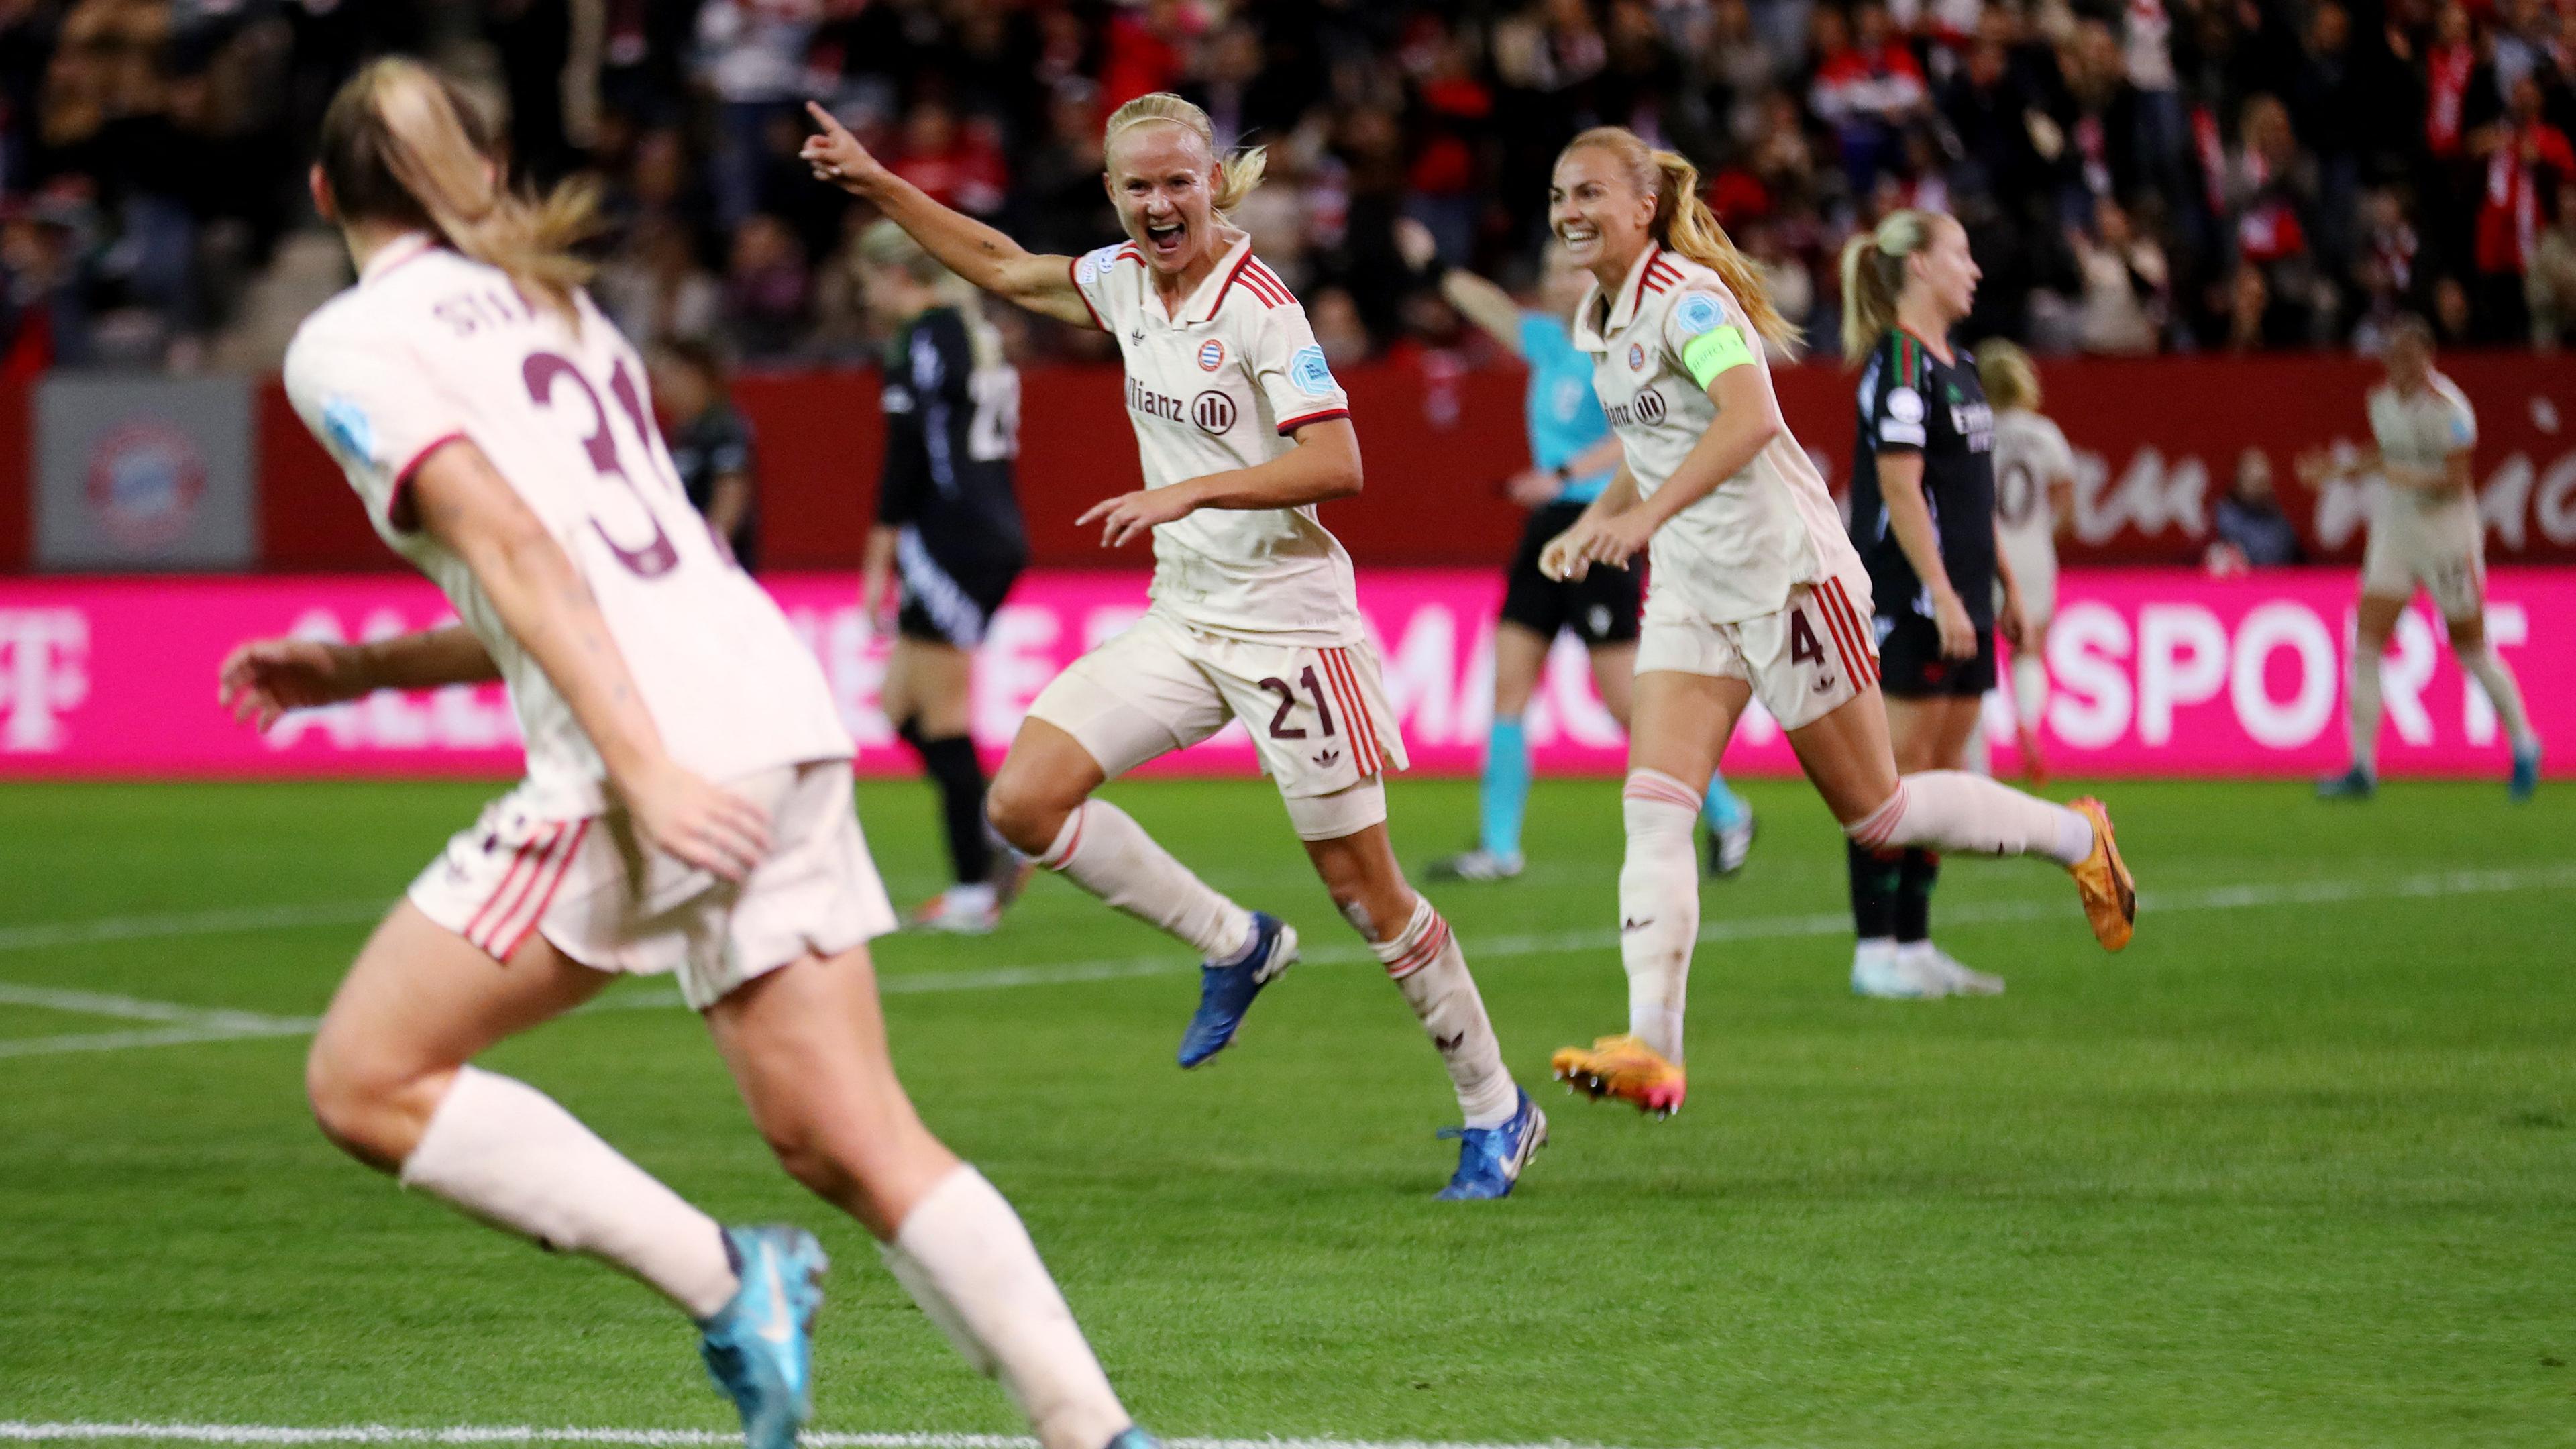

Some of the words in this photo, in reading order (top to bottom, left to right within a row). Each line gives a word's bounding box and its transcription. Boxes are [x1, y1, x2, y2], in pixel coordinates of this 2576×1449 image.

[1127, 376, 1186, 423] llianz
[1792, 607, 1826, 668] 4
[1258, 665, 1336, 739] 21
[2046, 599, 2530, 749] SPORT
